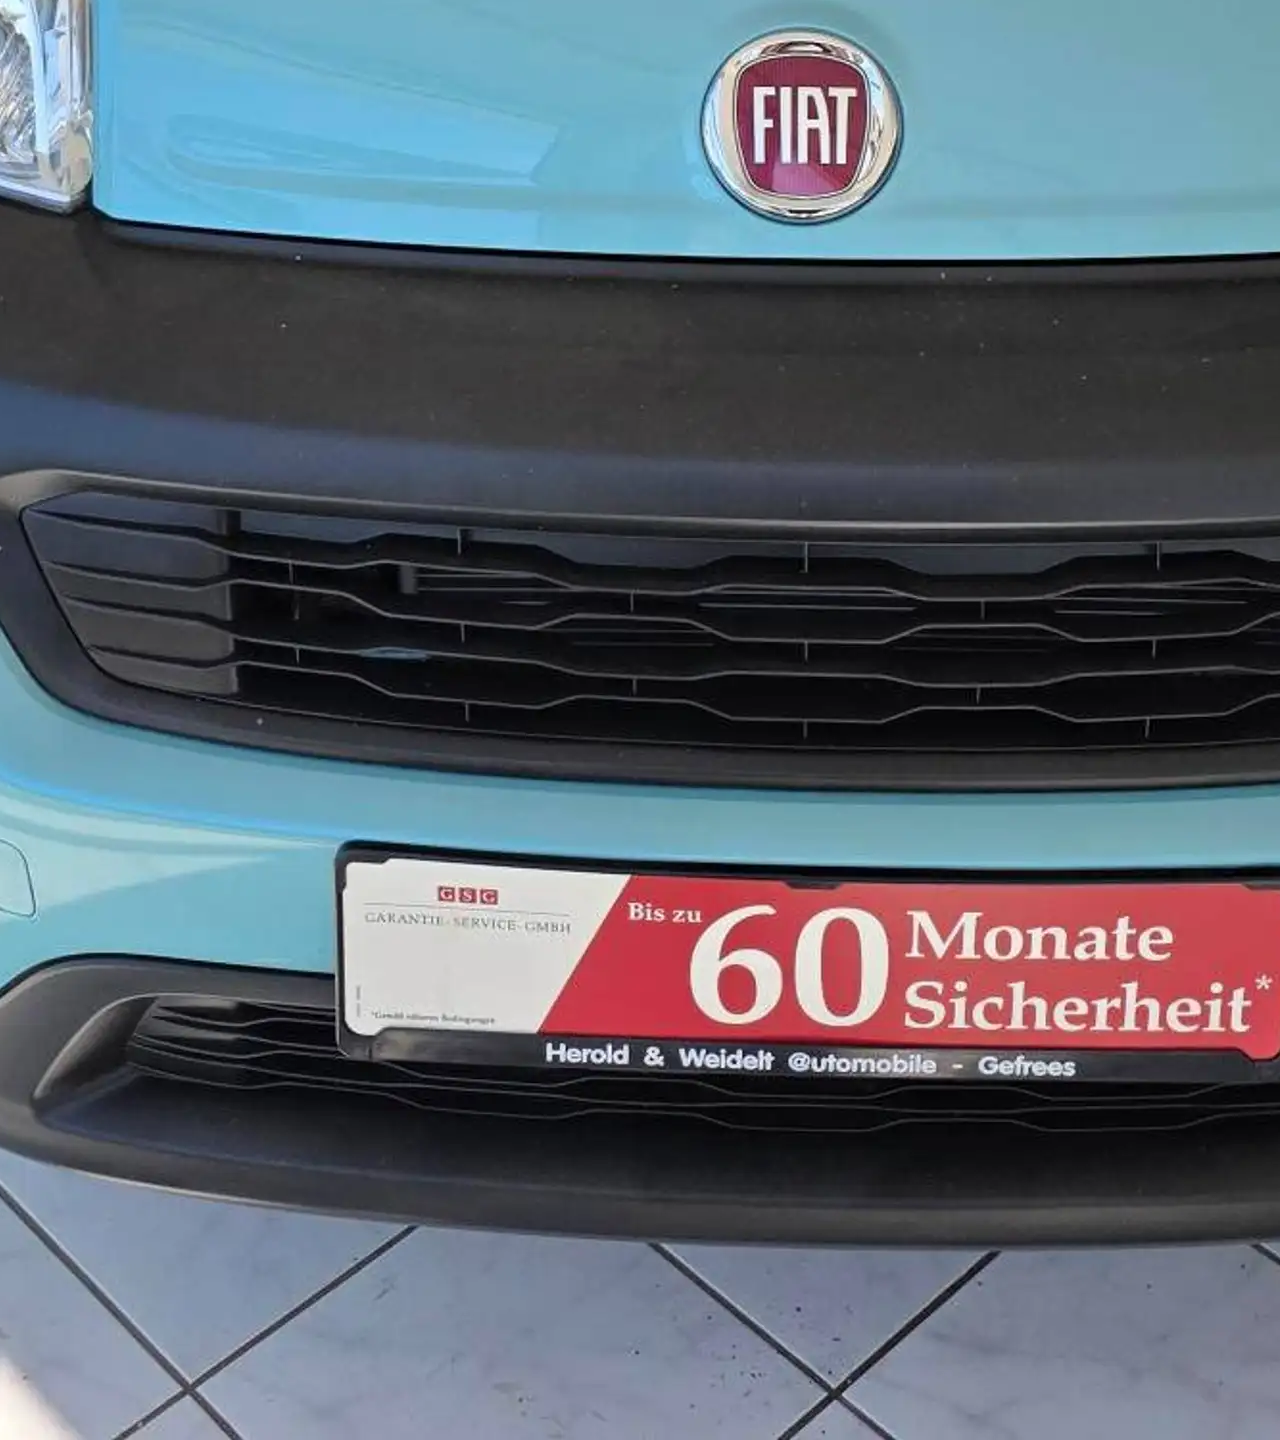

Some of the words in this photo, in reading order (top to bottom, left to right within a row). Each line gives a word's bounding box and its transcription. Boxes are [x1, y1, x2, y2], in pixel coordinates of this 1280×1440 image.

[752, 85, 858, 166] FIAT
[627, 902, 666, 923] Bis
[672, 909, 703, 924] zu
[689, 904, 890, 1027] 60
[904, 909, 1174, 962] Monate
[545, 1042, 630, 1066] Herold
[643, 1046, 665, 1067] &
[678, 1047, 775, 1072] Weidelt
[787, 1051, 937, 1074] @utomobile
[977, 1055, 1077, 1078] Gefrees
